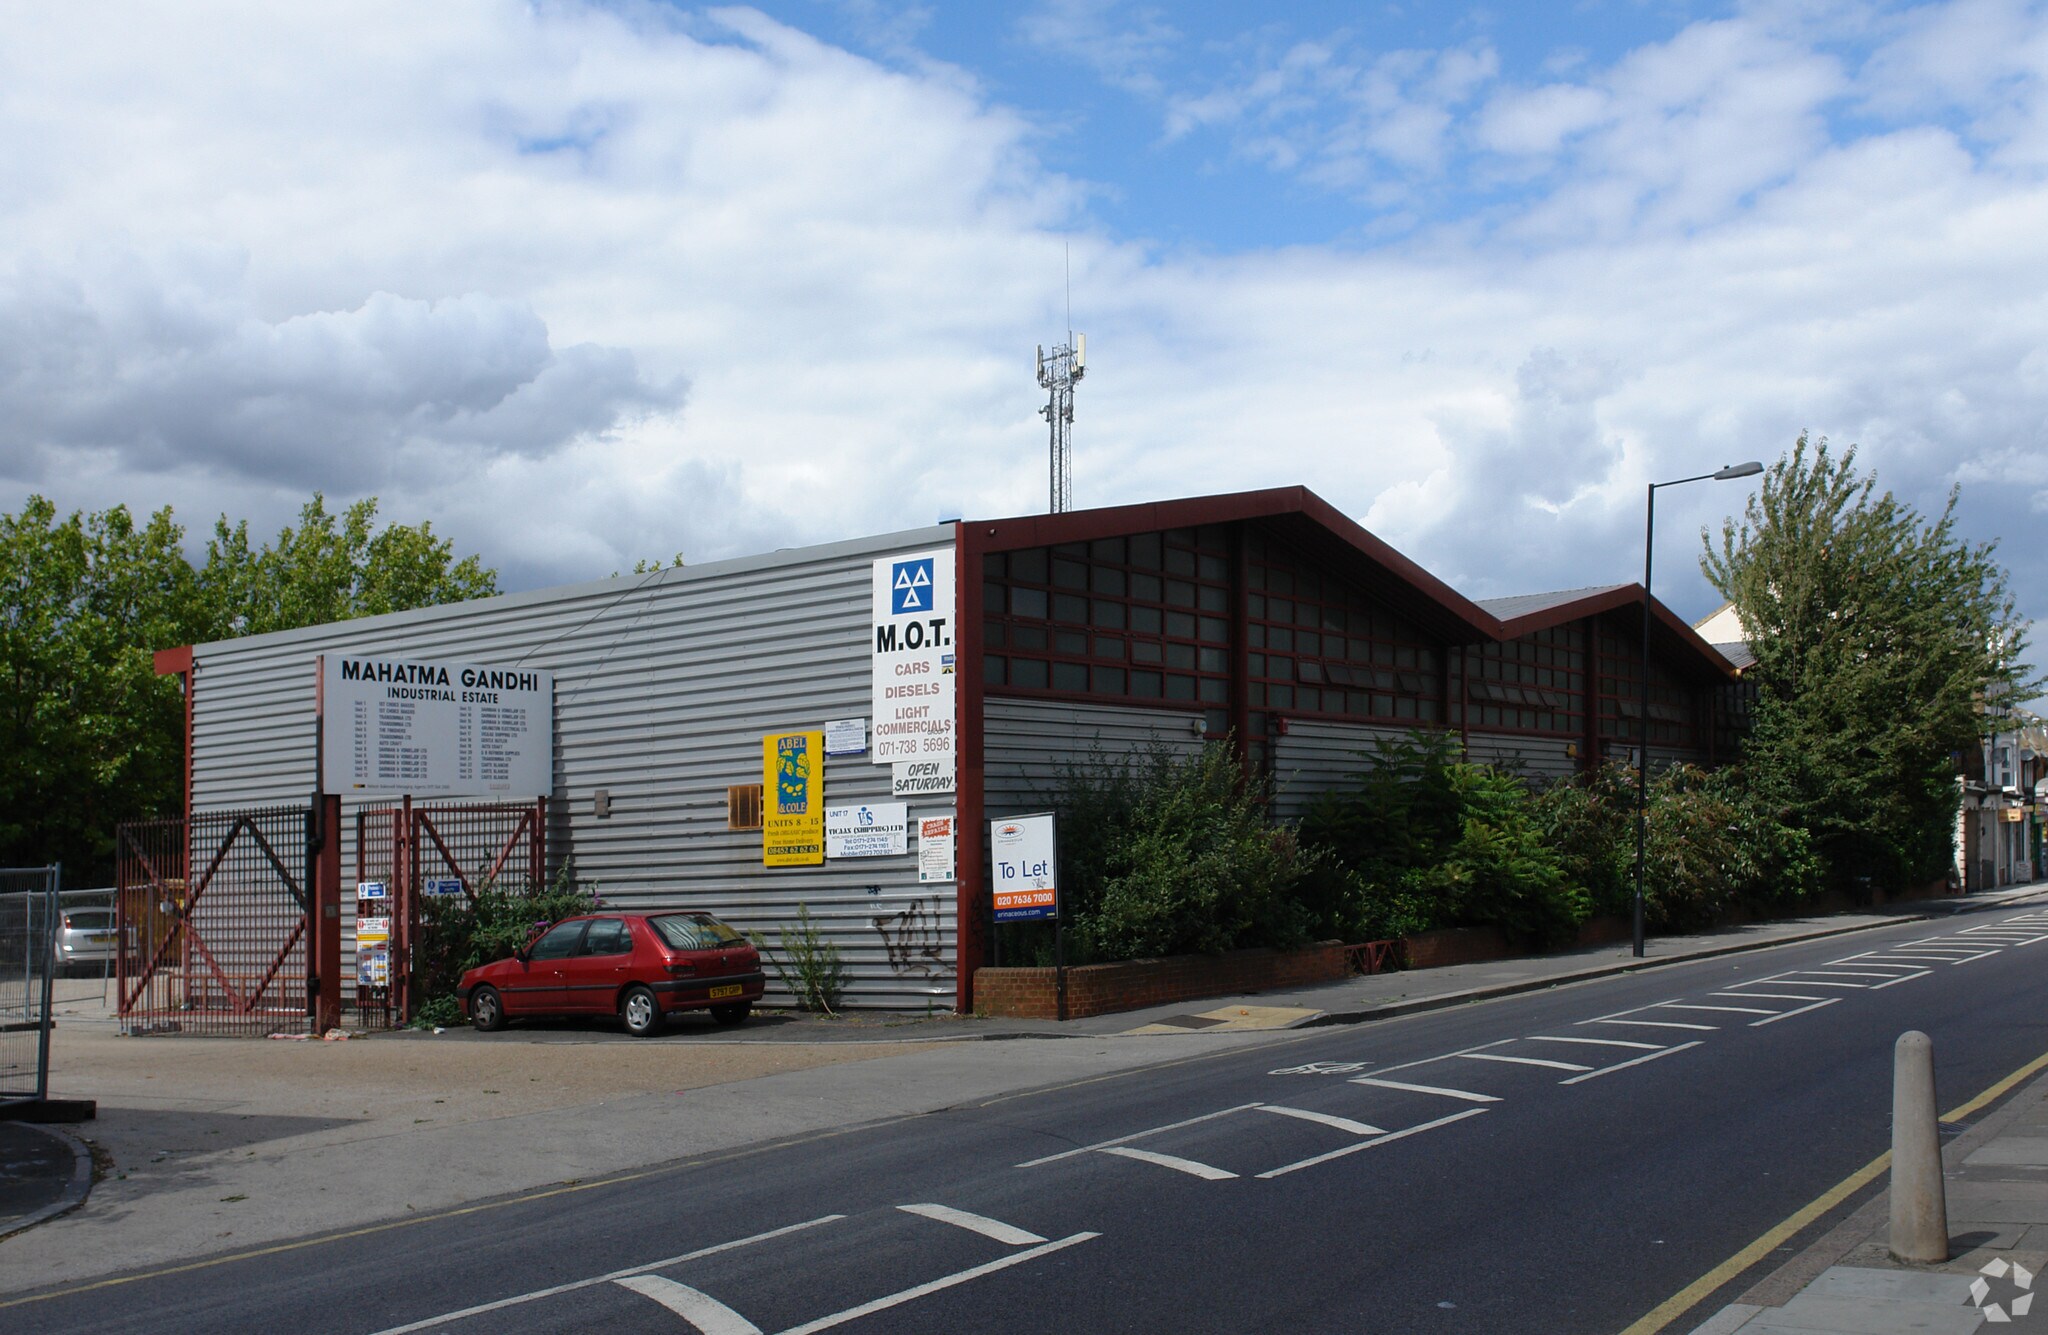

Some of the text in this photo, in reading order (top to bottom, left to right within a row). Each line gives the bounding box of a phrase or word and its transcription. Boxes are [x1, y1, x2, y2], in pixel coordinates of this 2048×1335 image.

[877, 618, 950, 653] M.O.T.
[342, 660, 538, 691] MAHATMA GANDHI
[895, 661, 930, 676] CARS
[387, 686, 498, 704] INDUSTRIAL ESTATE
[885, 682, 940, 699] DIESELS
[895, 706, 930, 720] LIGHT
[876, 719, 951, 736] COMMERCIALS
[779, 738, 806, 749] ABEL
[879, 739, 917, 755] 071-738
[923, 737, 950, 752] 5696
[908, 762, 940, 776] OPEN
[895, 776, 953, 792] SATURDAY
[998, 860, 1048, 879] To Let
[997, 893, 1052, 905] 020 7636 7000
[997, 909, 1040, 918] erinaceous.com
